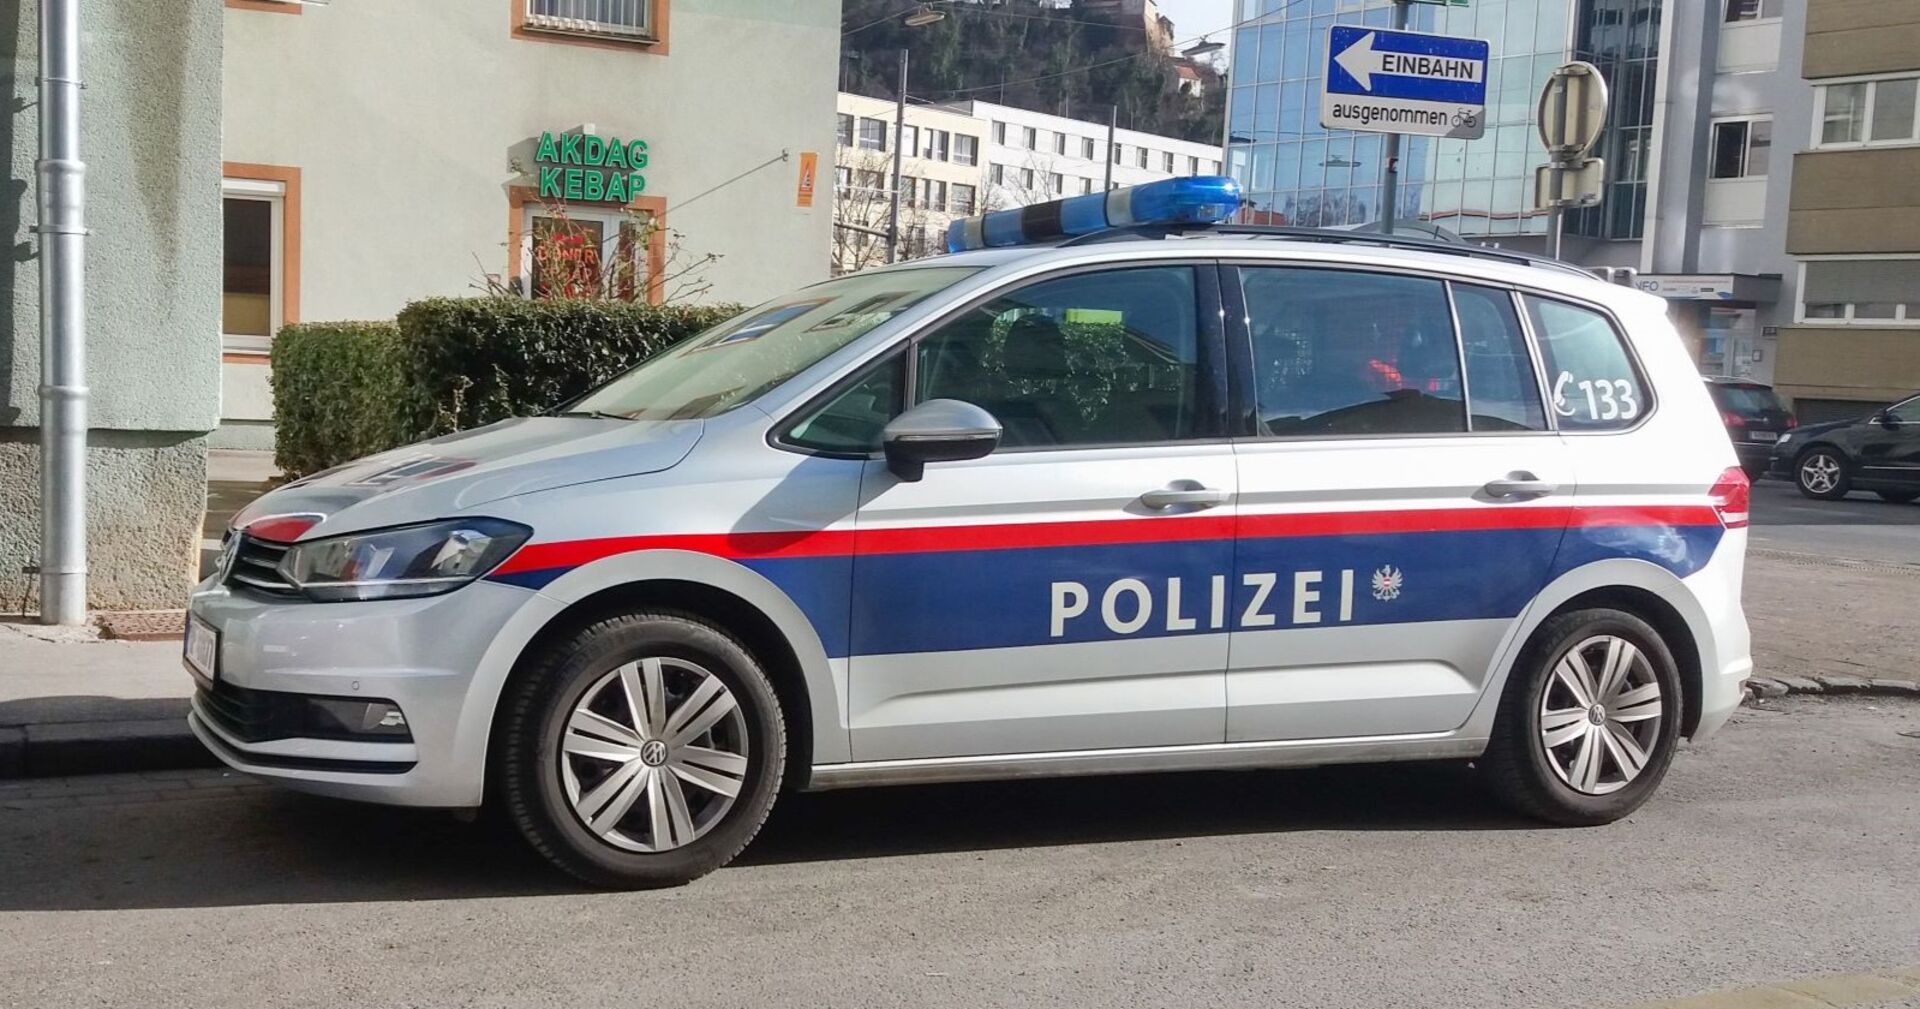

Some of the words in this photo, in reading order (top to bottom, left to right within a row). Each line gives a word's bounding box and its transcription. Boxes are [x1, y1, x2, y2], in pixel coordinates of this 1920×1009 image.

[1381, 53, 1474, 80] EINBAHN
[1332, 103, 1448, 126] ausgenommen
[536, 131, 649, 170] AKDAG
[540, 166, 646, 203] KEBAP
[1578, 379, 1638, 420] 133
[1050, 569, 1354, 638] POLIZEI
